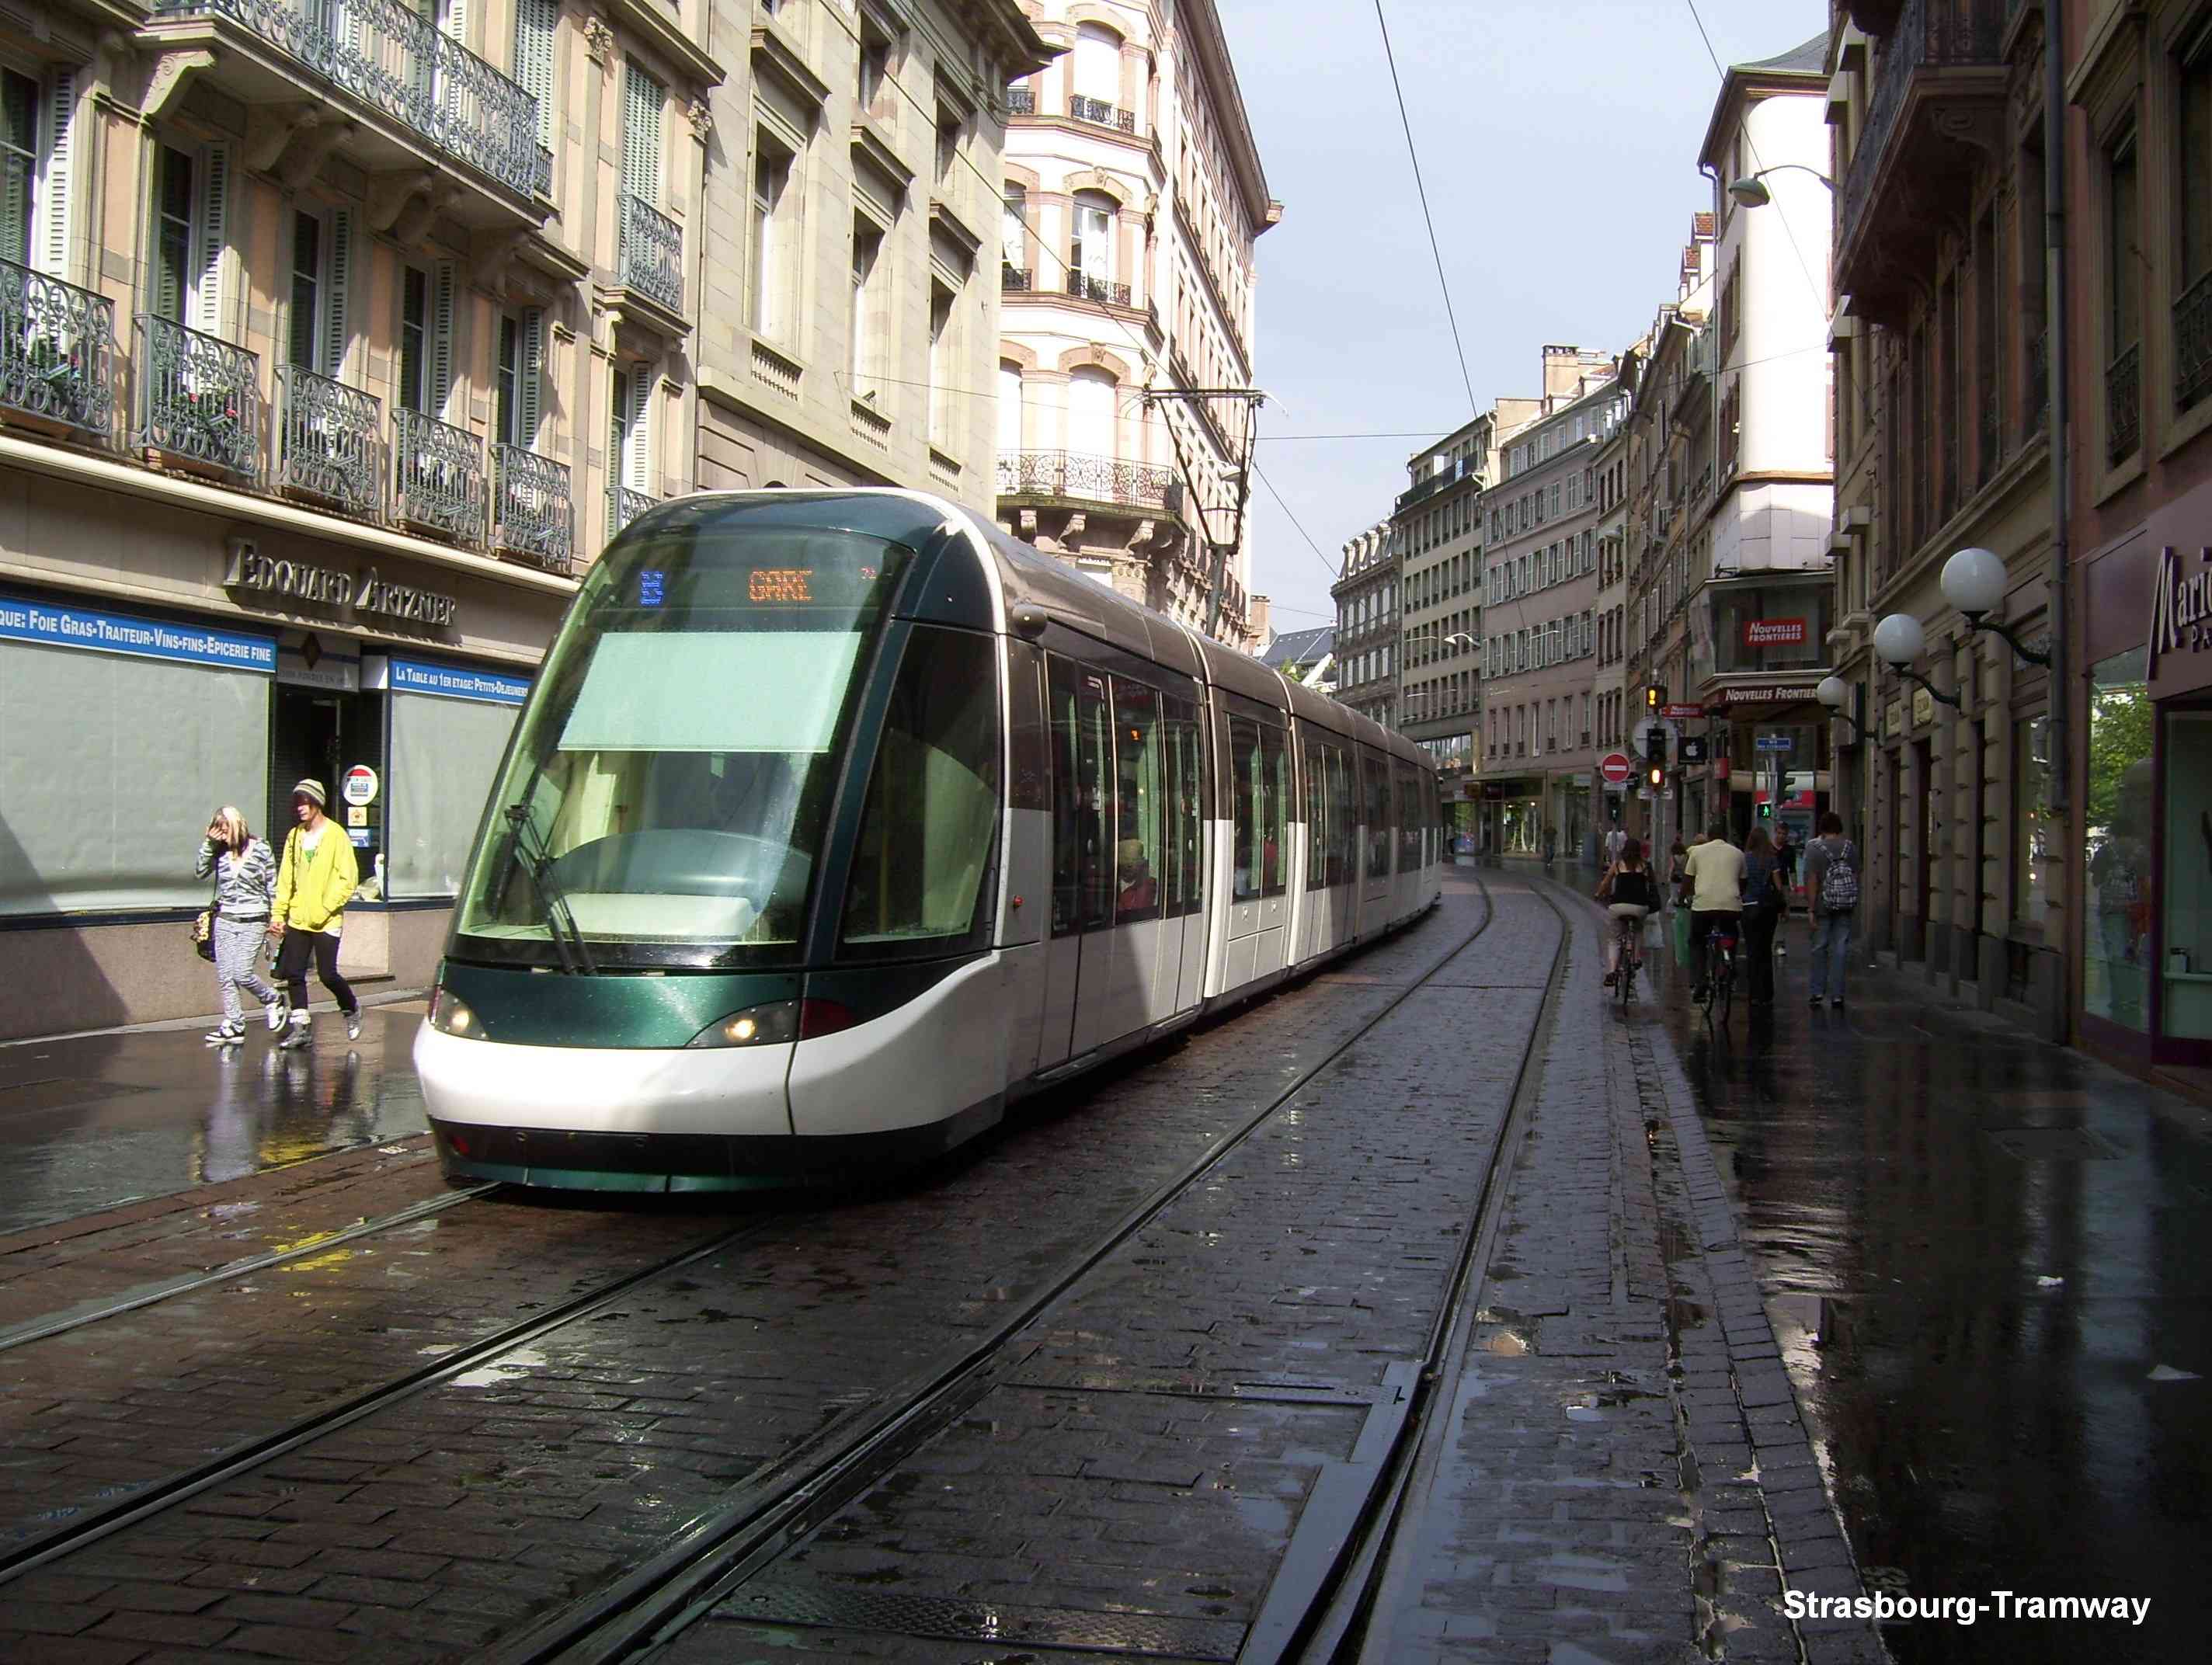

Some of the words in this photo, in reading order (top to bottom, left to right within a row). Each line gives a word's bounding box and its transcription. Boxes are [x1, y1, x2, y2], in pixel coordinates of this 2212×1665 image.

[223, 541, 352, 605] EDOUARD
[354, 565, 456, 626] ARTZNER
[30, 610, 57, 632] FOIE
[251, 647, 272, 662] FINE
[1749, 622, 1802, 634] NOUVELLES
[395, 666, 405, 680] LA
[406, 667, 428, 684] TABLE
[429, 674, 437, 685] AU
[1726, 689, 1772, 701] NOUVELLES
